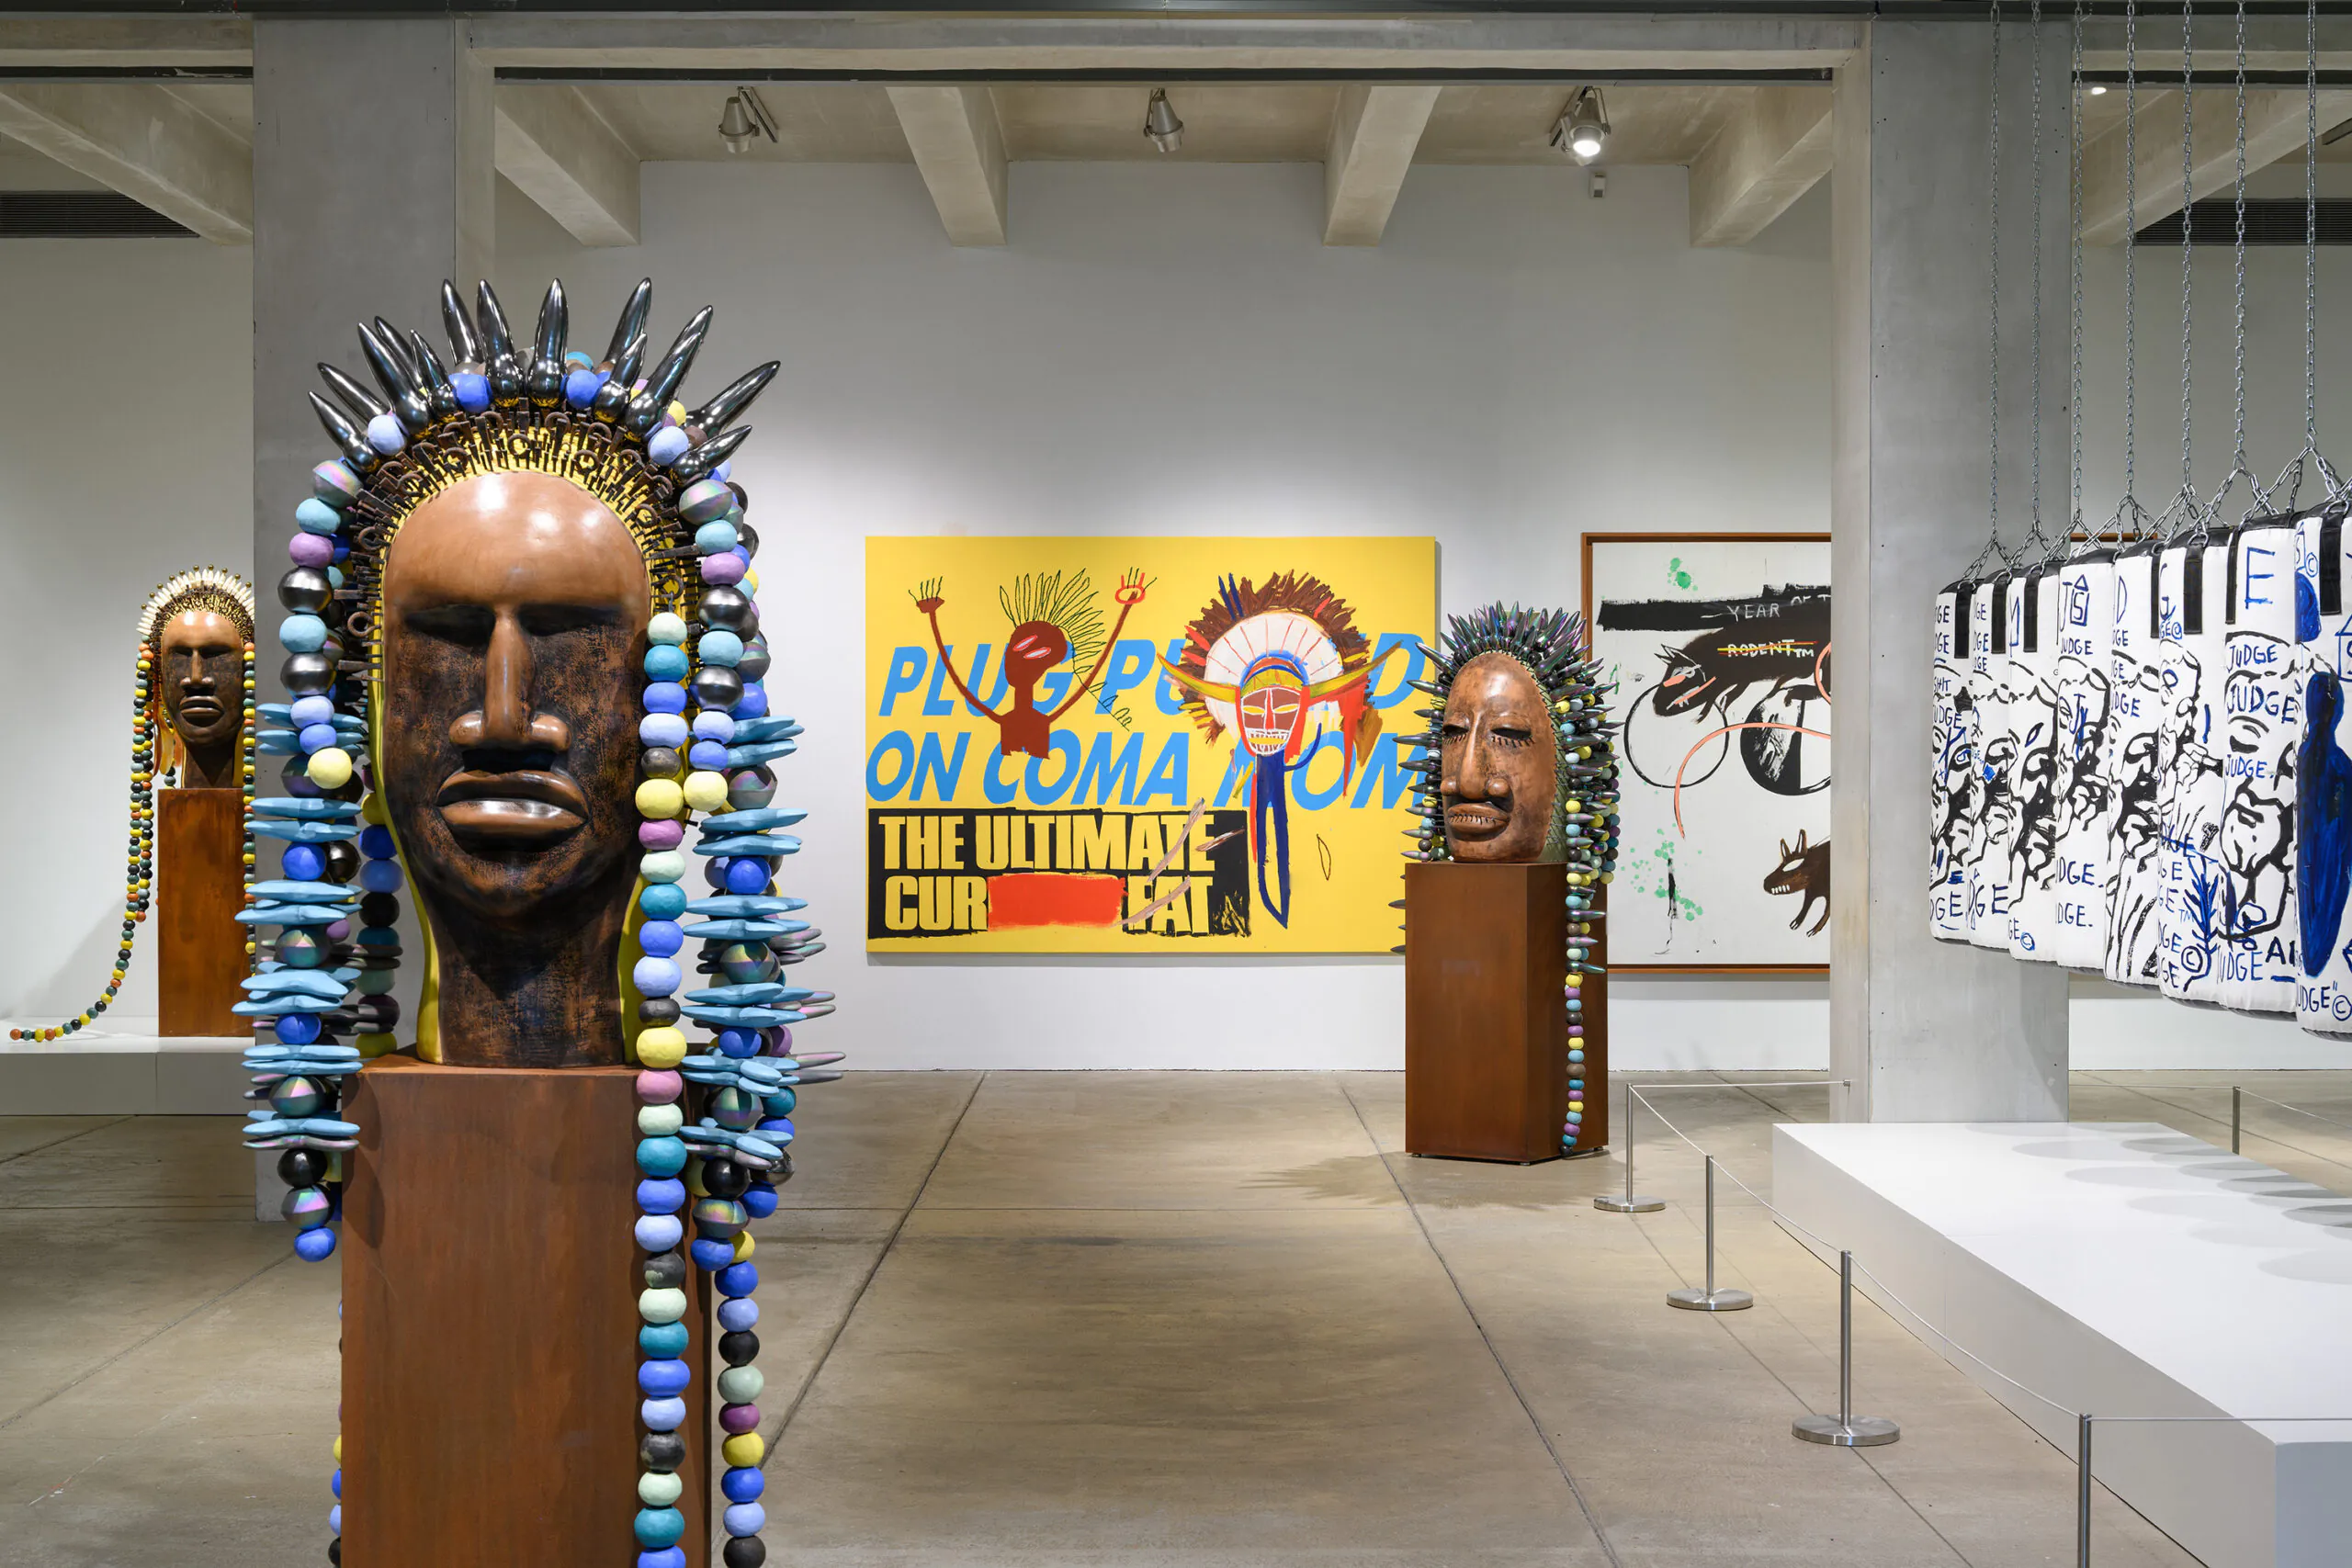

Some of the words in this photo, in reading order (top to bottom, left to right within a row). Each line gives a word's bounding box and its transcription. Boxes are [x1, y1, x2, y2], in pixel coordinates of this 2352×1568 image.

[1727, 603, 1780, 622] YEAR
[1727, 639, 1794, 657] RODENT
[2227, 644, 2278, 672] JUDGE
[878, 642, 1076, 716] PLUG
[2226, 683, 2295, 724] JUDGE
[865, 730, 971, 802] ON
[983, 729, 1190, 806] COMA
[879, 816, 964, 870] THE
[975, 815, 1216, 871] ULTIMATE
